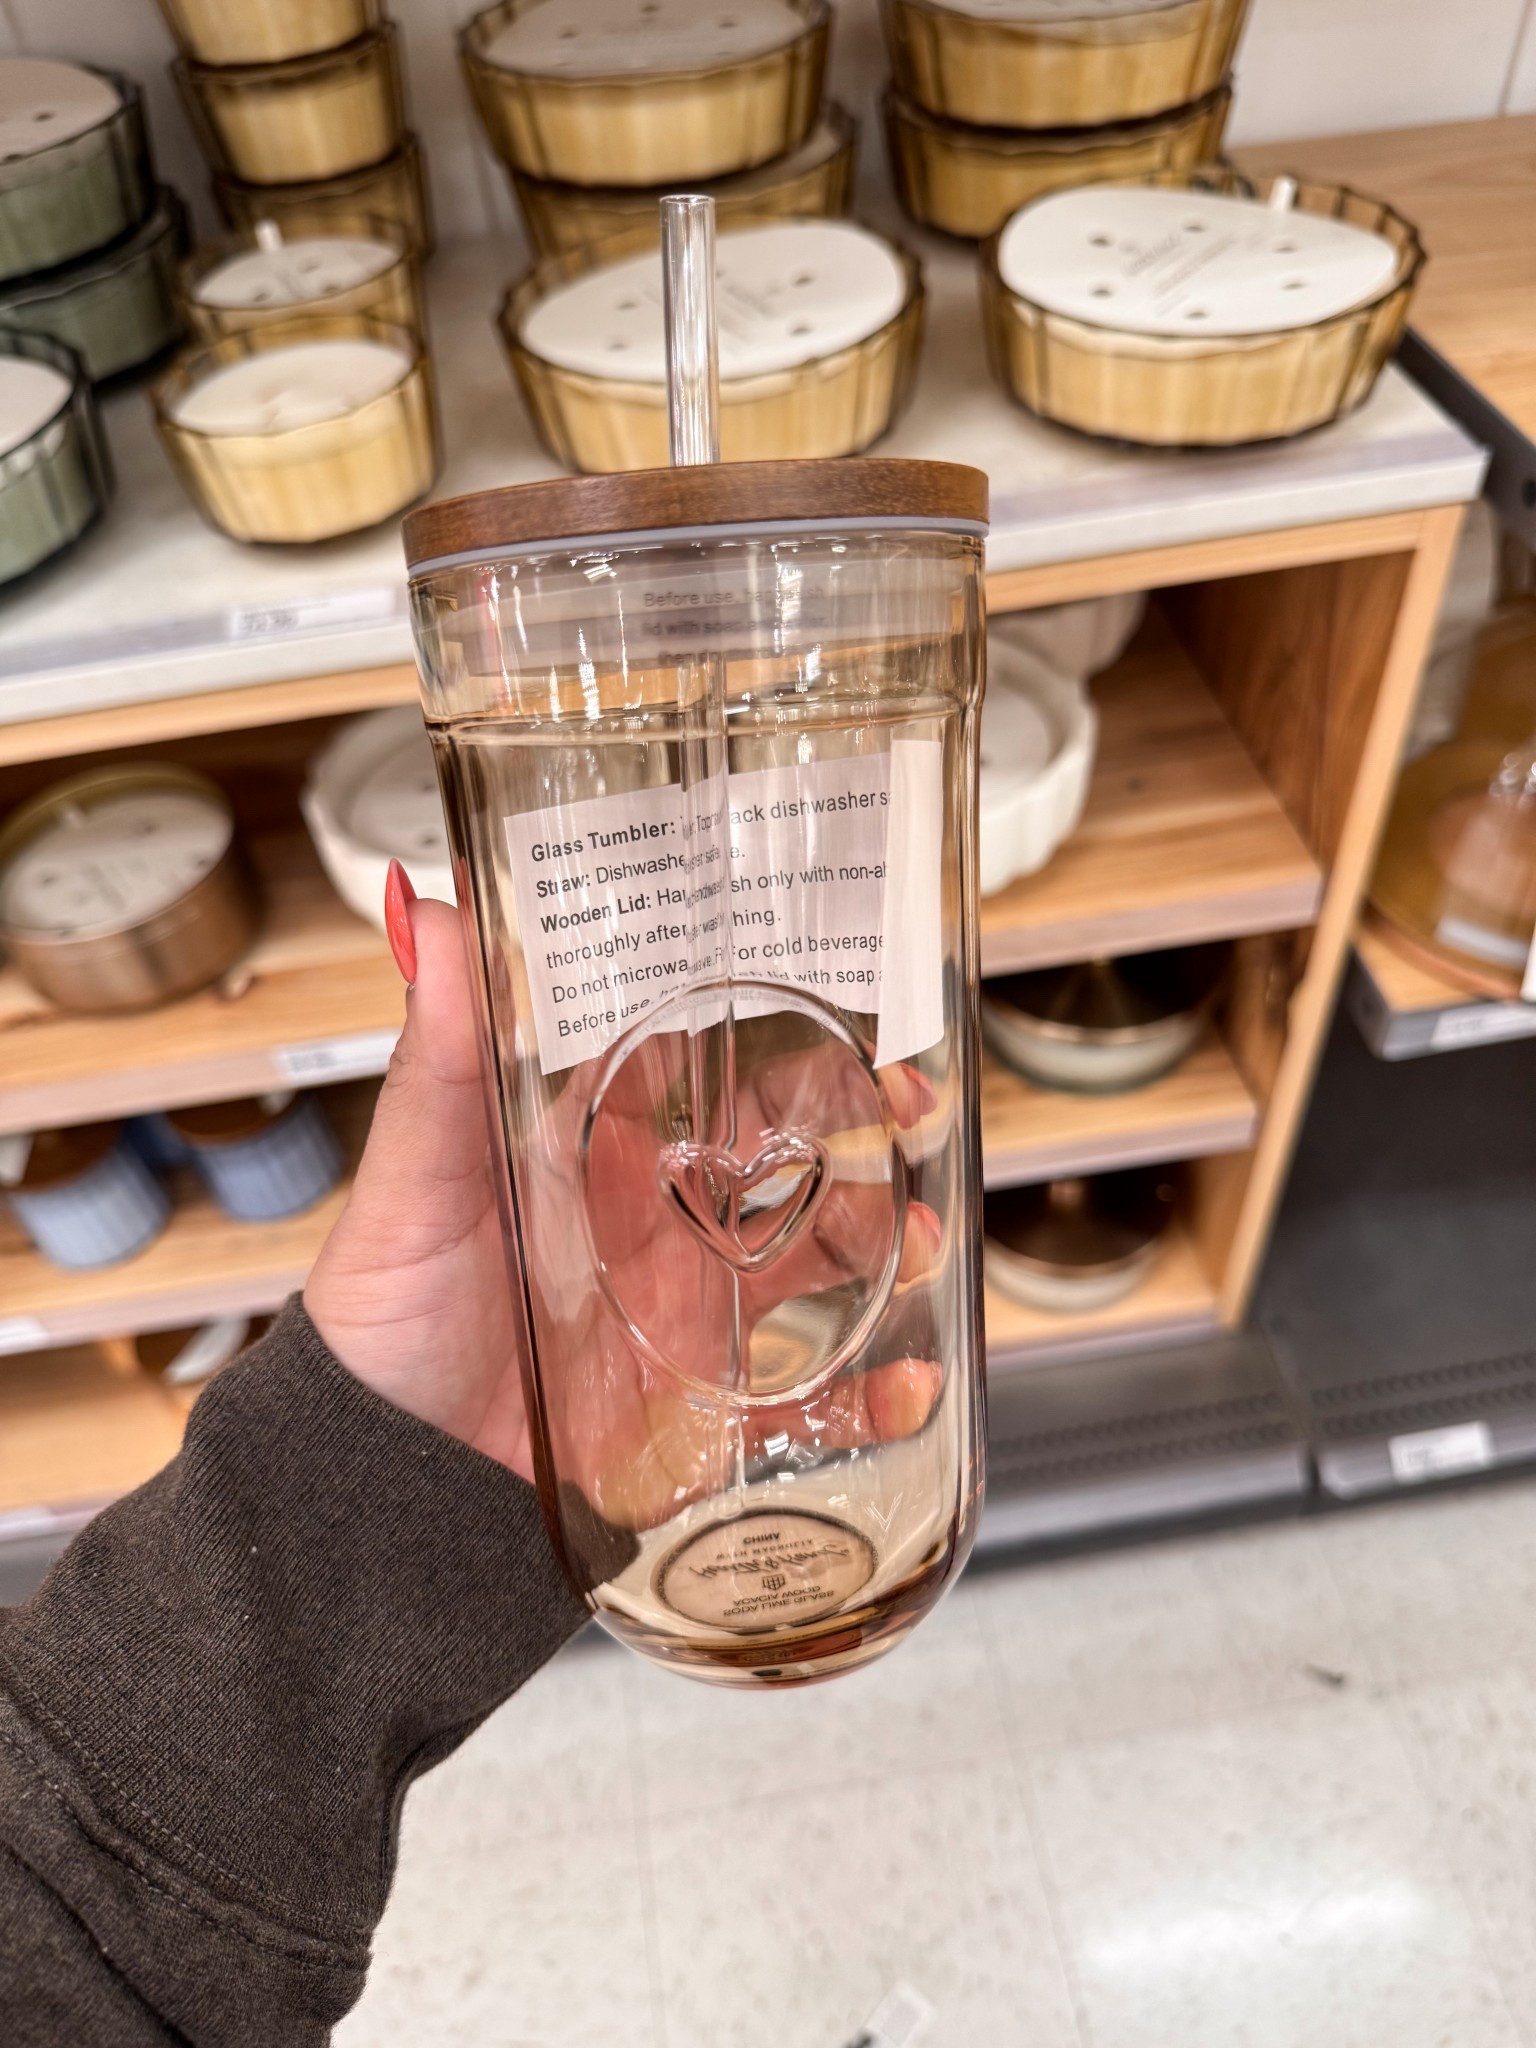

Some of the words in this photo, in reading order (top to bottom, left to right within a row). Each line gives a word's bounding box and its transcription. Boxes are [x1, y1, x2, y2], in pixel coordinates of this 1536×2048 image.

[643, 591, 699, 608] Before
[531, 839, 583, 862] Glass
[588, 822, 676, 850] Tumbler:
[770, 791, 875, 819] dishwasher
[536, 874, 591, 898] Straw:
[540, 906, 612, 934] Wooden
[617, 894, 651, 915] Lid:
[757, 870, 794, 890] only
[799, 865, 834, 884] with
[546, 932, 640, 969] thoroughly
[646, 923, 687, 944] after
[552, 985, 577, 1004] Do
[581, 974, 609, 996] not
[762, 937, 802, 958] cold
[558, 1010, 616, 1037] Before
[794, 968, 831, 985] with
[836, 969, 875, 986] soap
